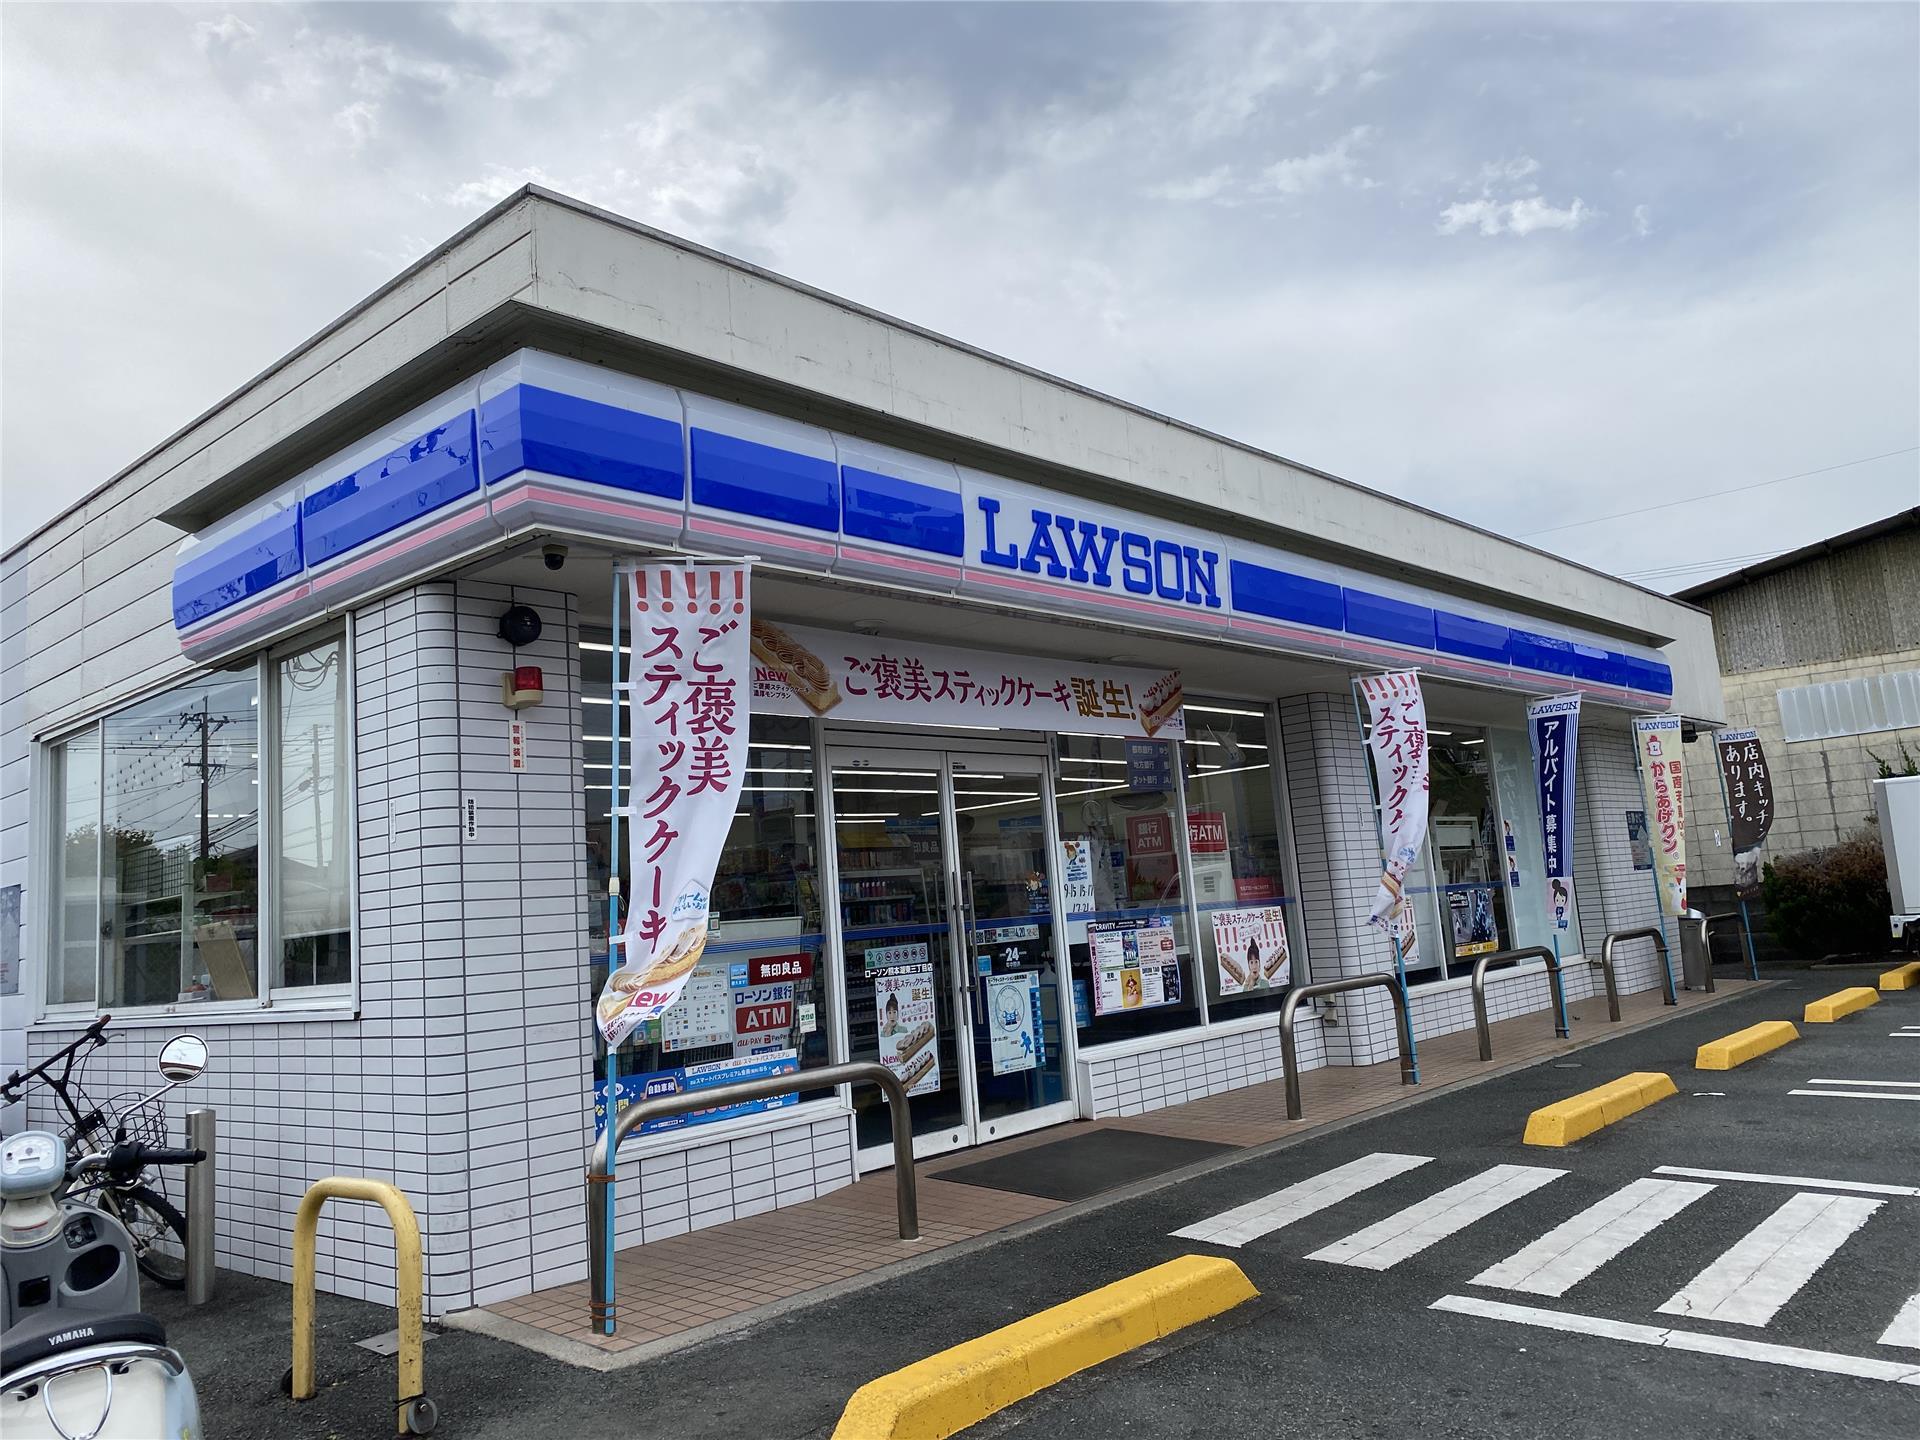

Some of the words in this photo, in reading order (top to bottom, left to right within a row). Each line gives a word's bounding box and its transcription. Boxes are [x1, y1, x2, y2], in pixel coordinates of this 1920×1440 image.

[978, 496, 1221, 608] LAWSON
[755, 667, 788, 682] New
[684, 619, 740, 796] ご褒美
[1531, 701, 1578, 716] LAWSON
[1638, 720, 1680, 731] LAWSON
[1719, 731, 1757, 741] LAWSON
[639, 626, 685, 954] スティックケーキ
[1726, 745, 1753, 823] あります。
[1744, 743, 1769, 840] 店内キッチン
[1543, 720, 1560, 875] アルバイト募集中
[1650, 761, 1678, 854] からあげクン
[1138, 821, 1158, 835] 銀行
[1189, 825, 1223, 841] 行ATM
[1137, 837, 1162, 849] ATM
[1005, 947, 1020, 962] 24
[760, 960, 802, 978] 無印良品
[735, 985, 793, 1005] ローソン銀行
[745, 1006, 786, 1029] ATM
[691, 1063, 721, 1075] LAWSON
[49, 1326, 95, 1347] YAMAHA
